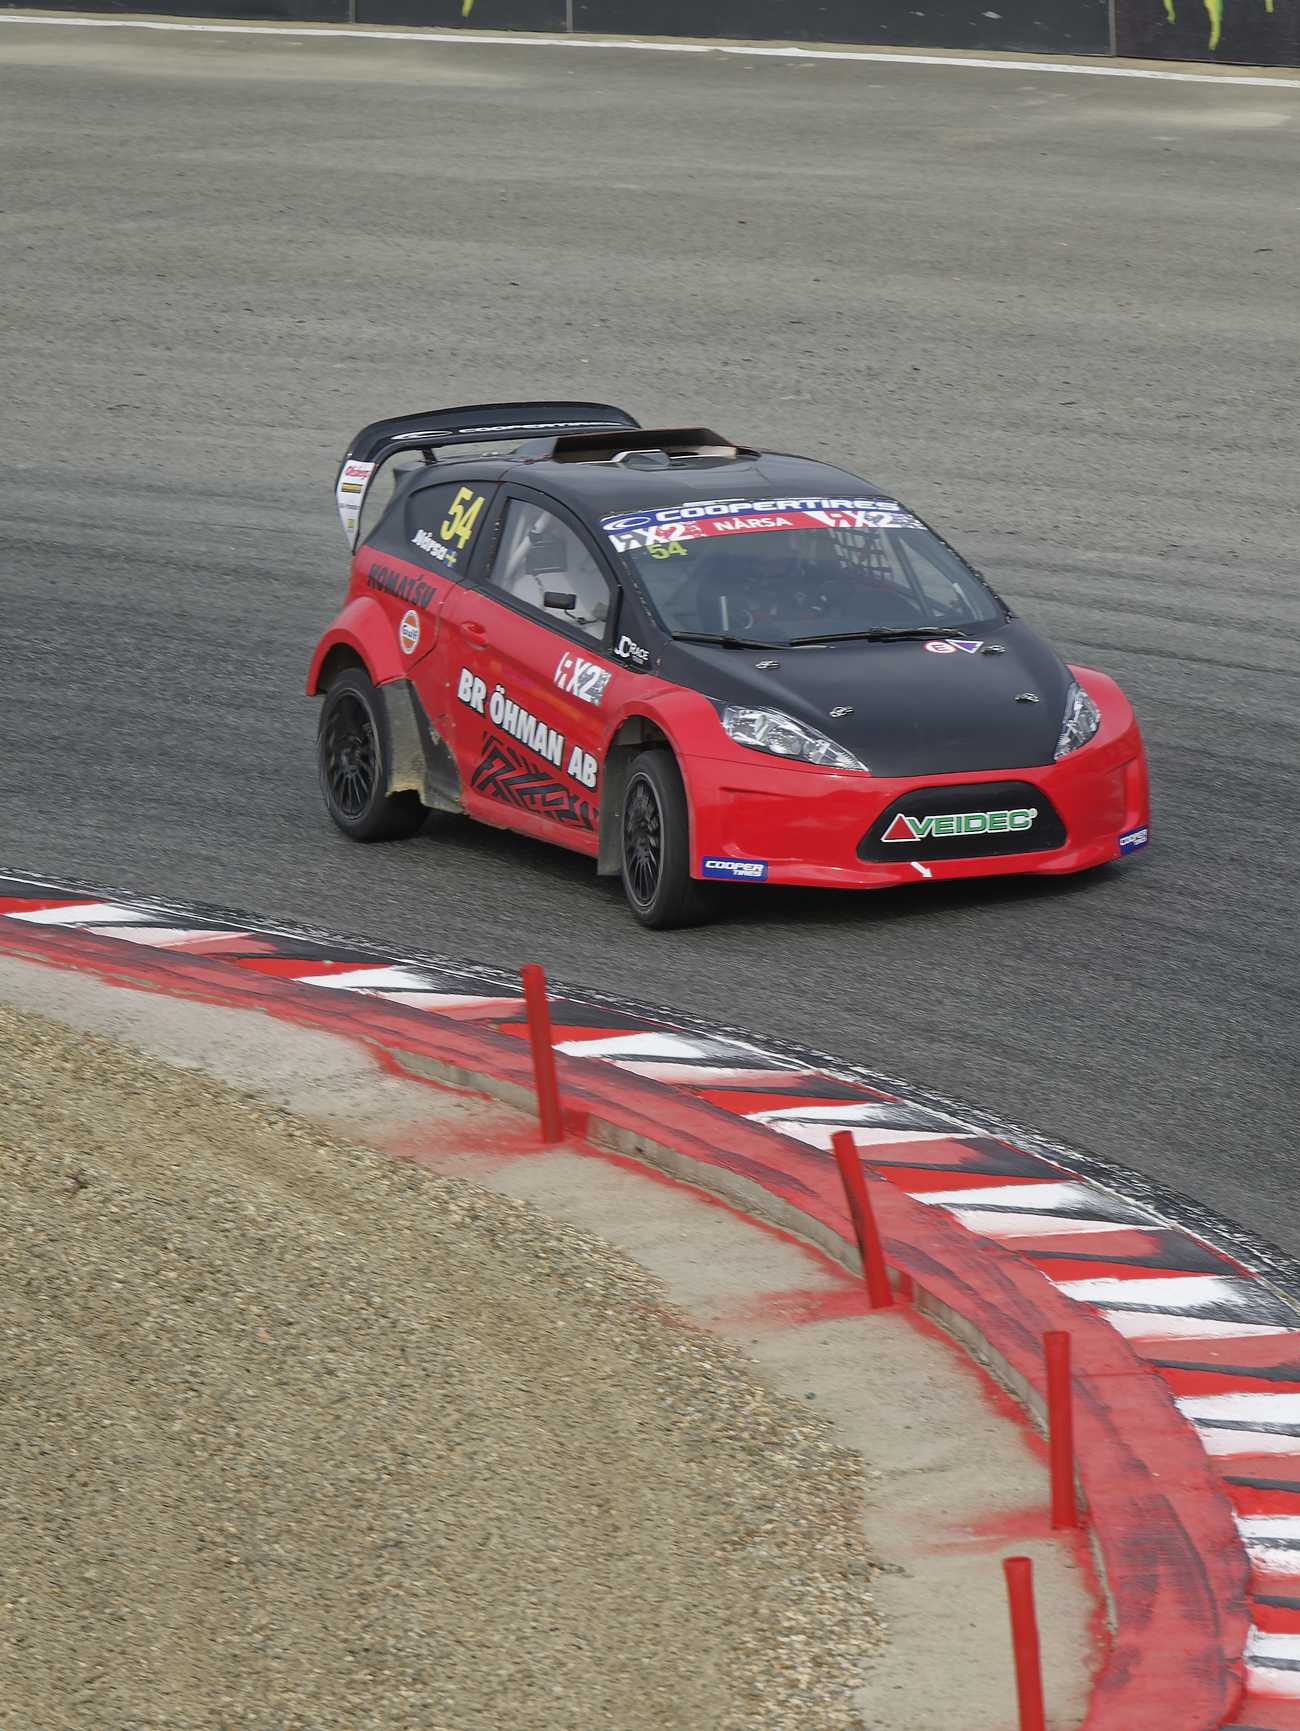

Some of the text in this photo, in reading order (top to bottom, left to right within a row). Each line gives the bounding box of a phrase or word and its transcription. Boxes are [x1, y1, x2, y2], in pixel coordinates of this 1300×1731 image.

[440, 487, 485, 549] 54
[655, 499, 900, 522] COOPERTIRES
[647, 541, 688, 560] 54
[457, 667, 599, 789] BR ÖHMAN AB
[908, 811, 1034, 837] VEIDEC
[705, 860, 765, 873] COOPER
